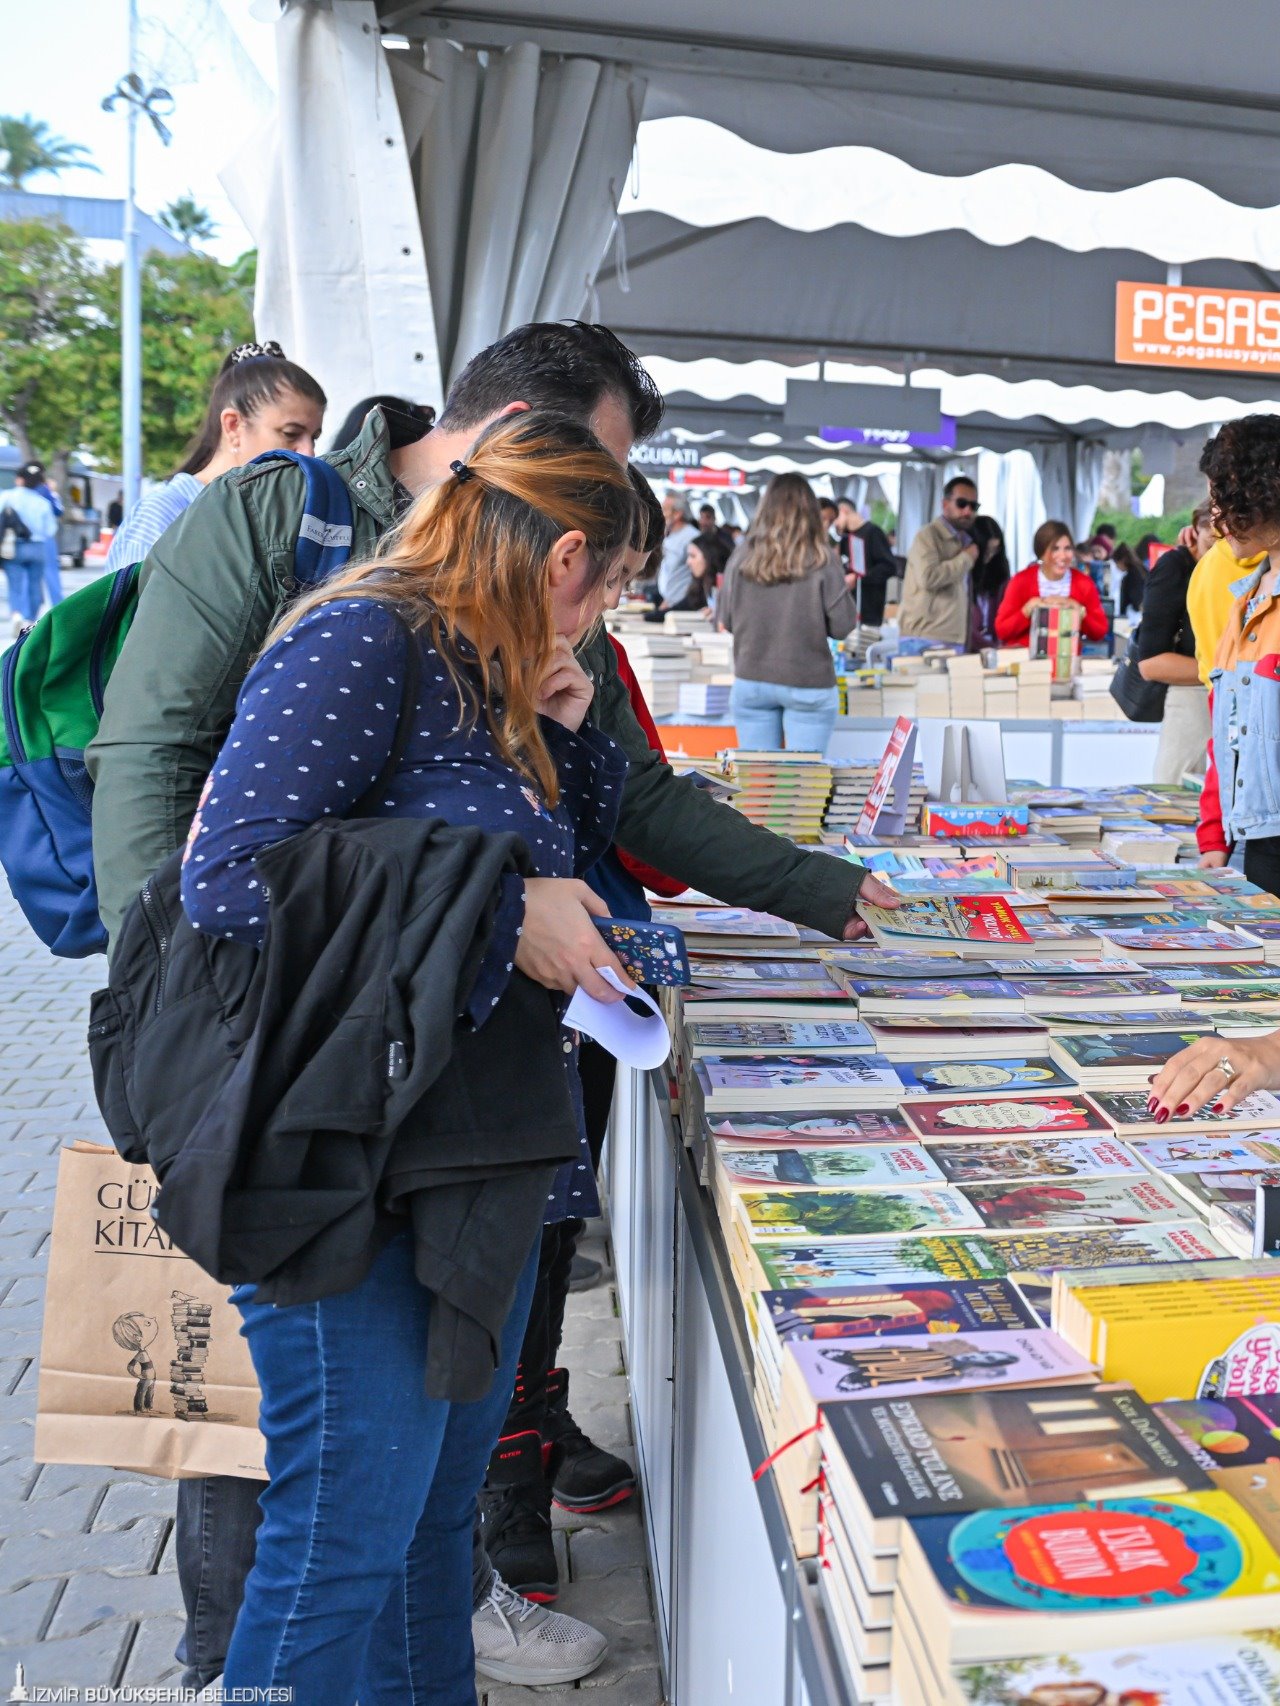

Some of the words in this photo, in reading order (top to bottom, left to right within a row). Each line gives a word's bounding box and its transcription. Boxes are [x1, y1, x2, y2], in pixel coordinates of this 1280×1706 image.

[627, 443, 699, 466] OĞUBATI
[888, 1400, 933, 1453] EDWARD
[915, 1449, 963, 1502] TULANE
[1038, 1526, 1115, 1581] BURUN
[1097, 1525, 1171, 1574] ISLAK
